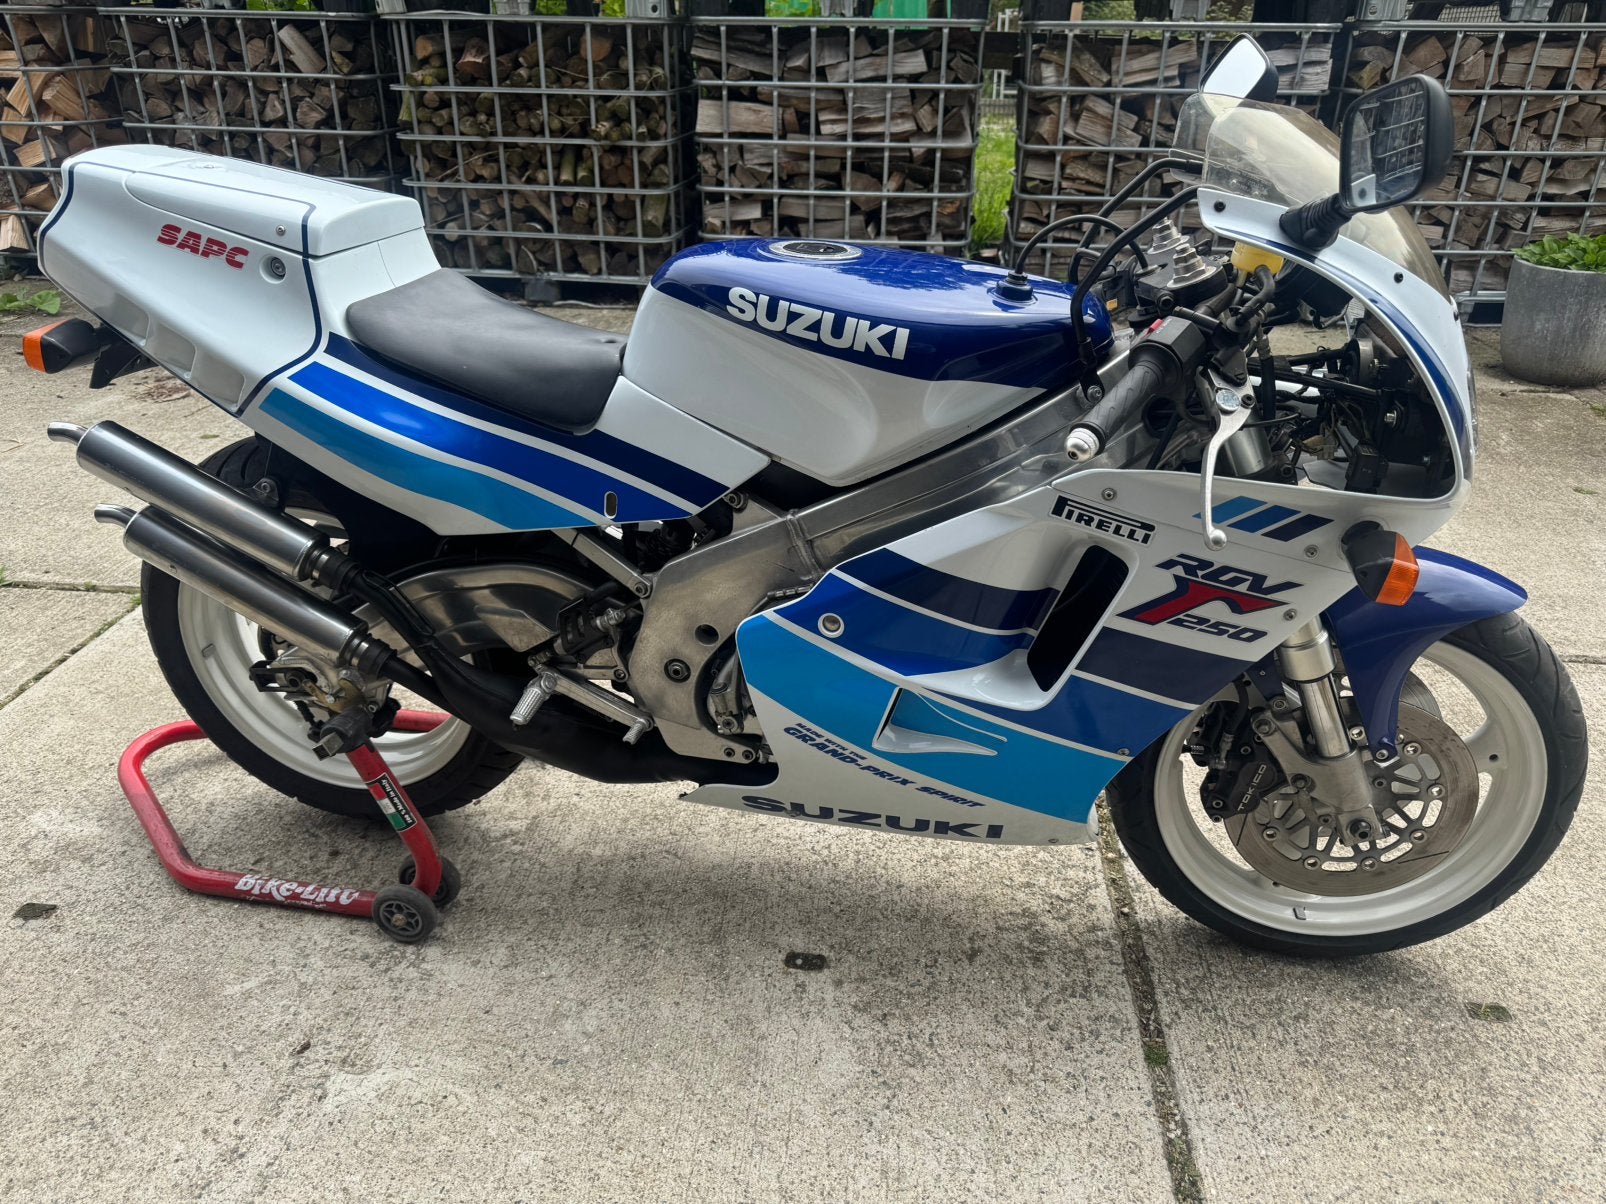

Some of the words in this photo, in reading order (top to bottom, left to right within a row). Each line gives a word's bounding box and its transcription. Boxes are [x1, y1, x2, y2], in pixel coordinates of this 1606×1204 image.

[156, 223, 250, 270] SAPC
[726, 286, 910, 360] SUZUKI
[1051, 494, 1157, 545] PIRELLI
[1154, 553, 1305, 596] RGV
[1166, 613, 1268, 643] 250
[915, 786, 986, 808] SPIRIT
[1237, 763, 1267, 812] TOKICO
[741, 795, 1004, 839] SUZUKI
